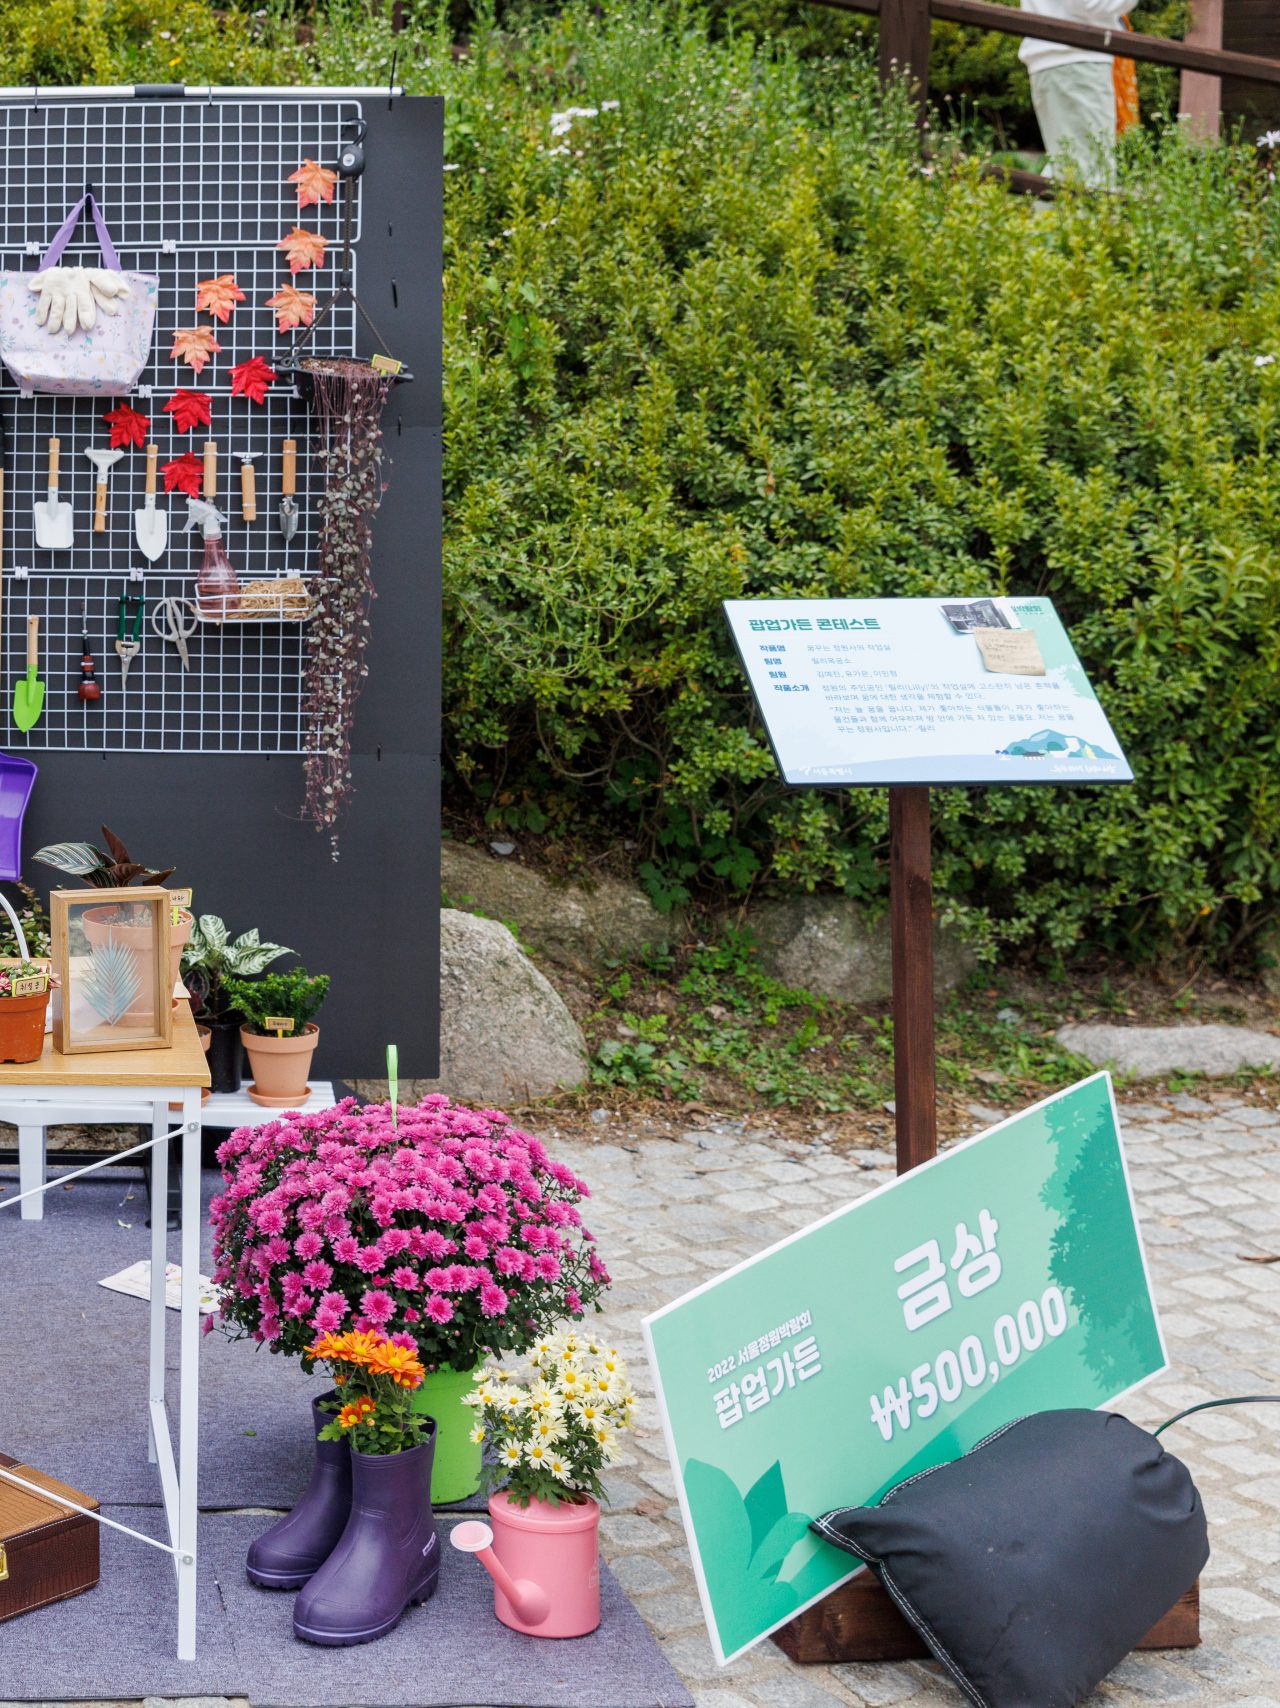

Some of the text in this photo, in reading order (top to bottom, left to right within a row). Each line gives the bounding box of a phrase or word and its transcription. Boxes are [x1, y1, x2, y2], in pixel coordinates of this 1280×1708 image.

[748, 618, 881, 631] 팝업가든 콘테스트
[759, 644, 786, 652] 작품명
[764, 657, 782, 665] 팀명
[769, 670, 787, 678] 팀원
[773, 684, 809, 692] 작품소개
[894, 1208, 1002, 1332] 금상
[707, 1309, 813, 1383] 2022 서울정원박람회
[870, 1286, 1068, 1441] ₩500,000
[713, 1335, 822, 1430] 팝업가든
